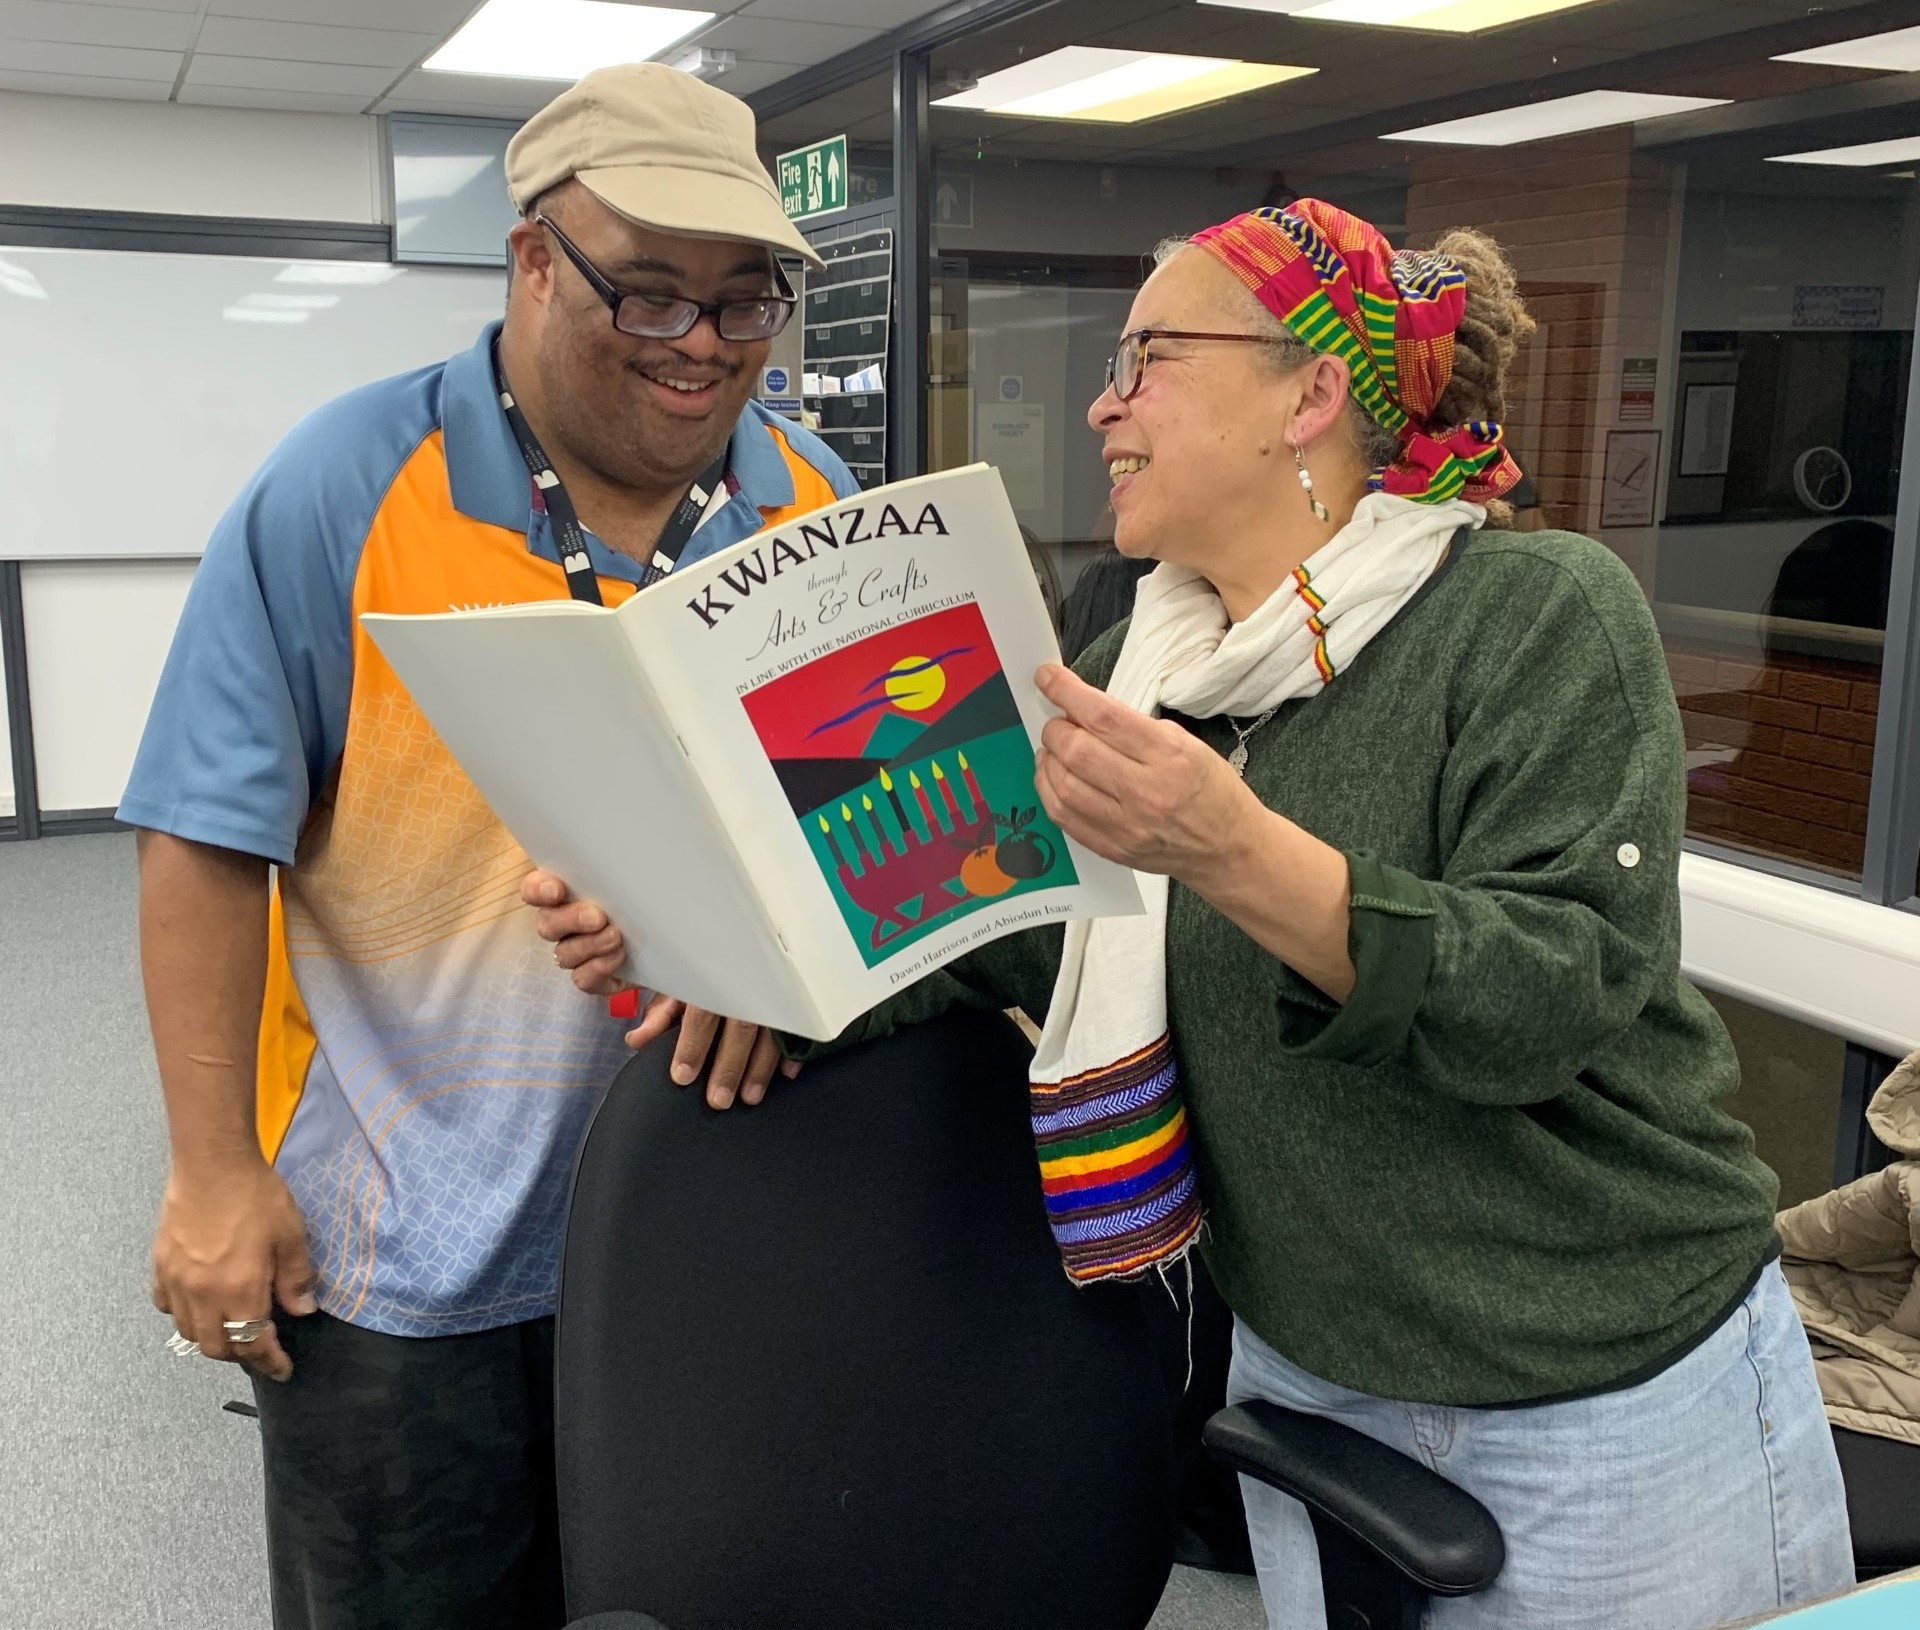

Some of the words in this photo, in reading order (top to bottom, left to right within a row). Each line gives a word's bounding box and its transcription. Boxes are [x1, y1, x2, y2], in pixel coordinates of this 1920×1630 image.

[781, 162, 801, 188] Fire
[784, 188, 802, 215] exit
[563, 533, 573, 552] BLACK
[565, 521, 579, 550] BUSINESS
[575, 530, 584, 549] SHOW
[686, 503, 949, 630] KWANZAA
[808, 560, 848, 592] through
[745, 609, 806, 662] Arts
[818, 589, 848, 624] &
[858, 557, 928, 608] Crafts
[736, 681, 749, 695] IN
[750, 667, 777, 688] LINE
[777, 652, 809, 674] WITH
[810, 640, 835, 658] THE
[835, 617, 896, 645] NATIONAL
[897, 590, 975, 621] CURRICULUM
[889, 962, 922, 984] Dawn
[922, 935, 969, 965] Harrison
[971, 923, 991, 940] and
[994, 906, 1042, 930] Abiodun
[1044, 903, 1074, 915] Isaac
